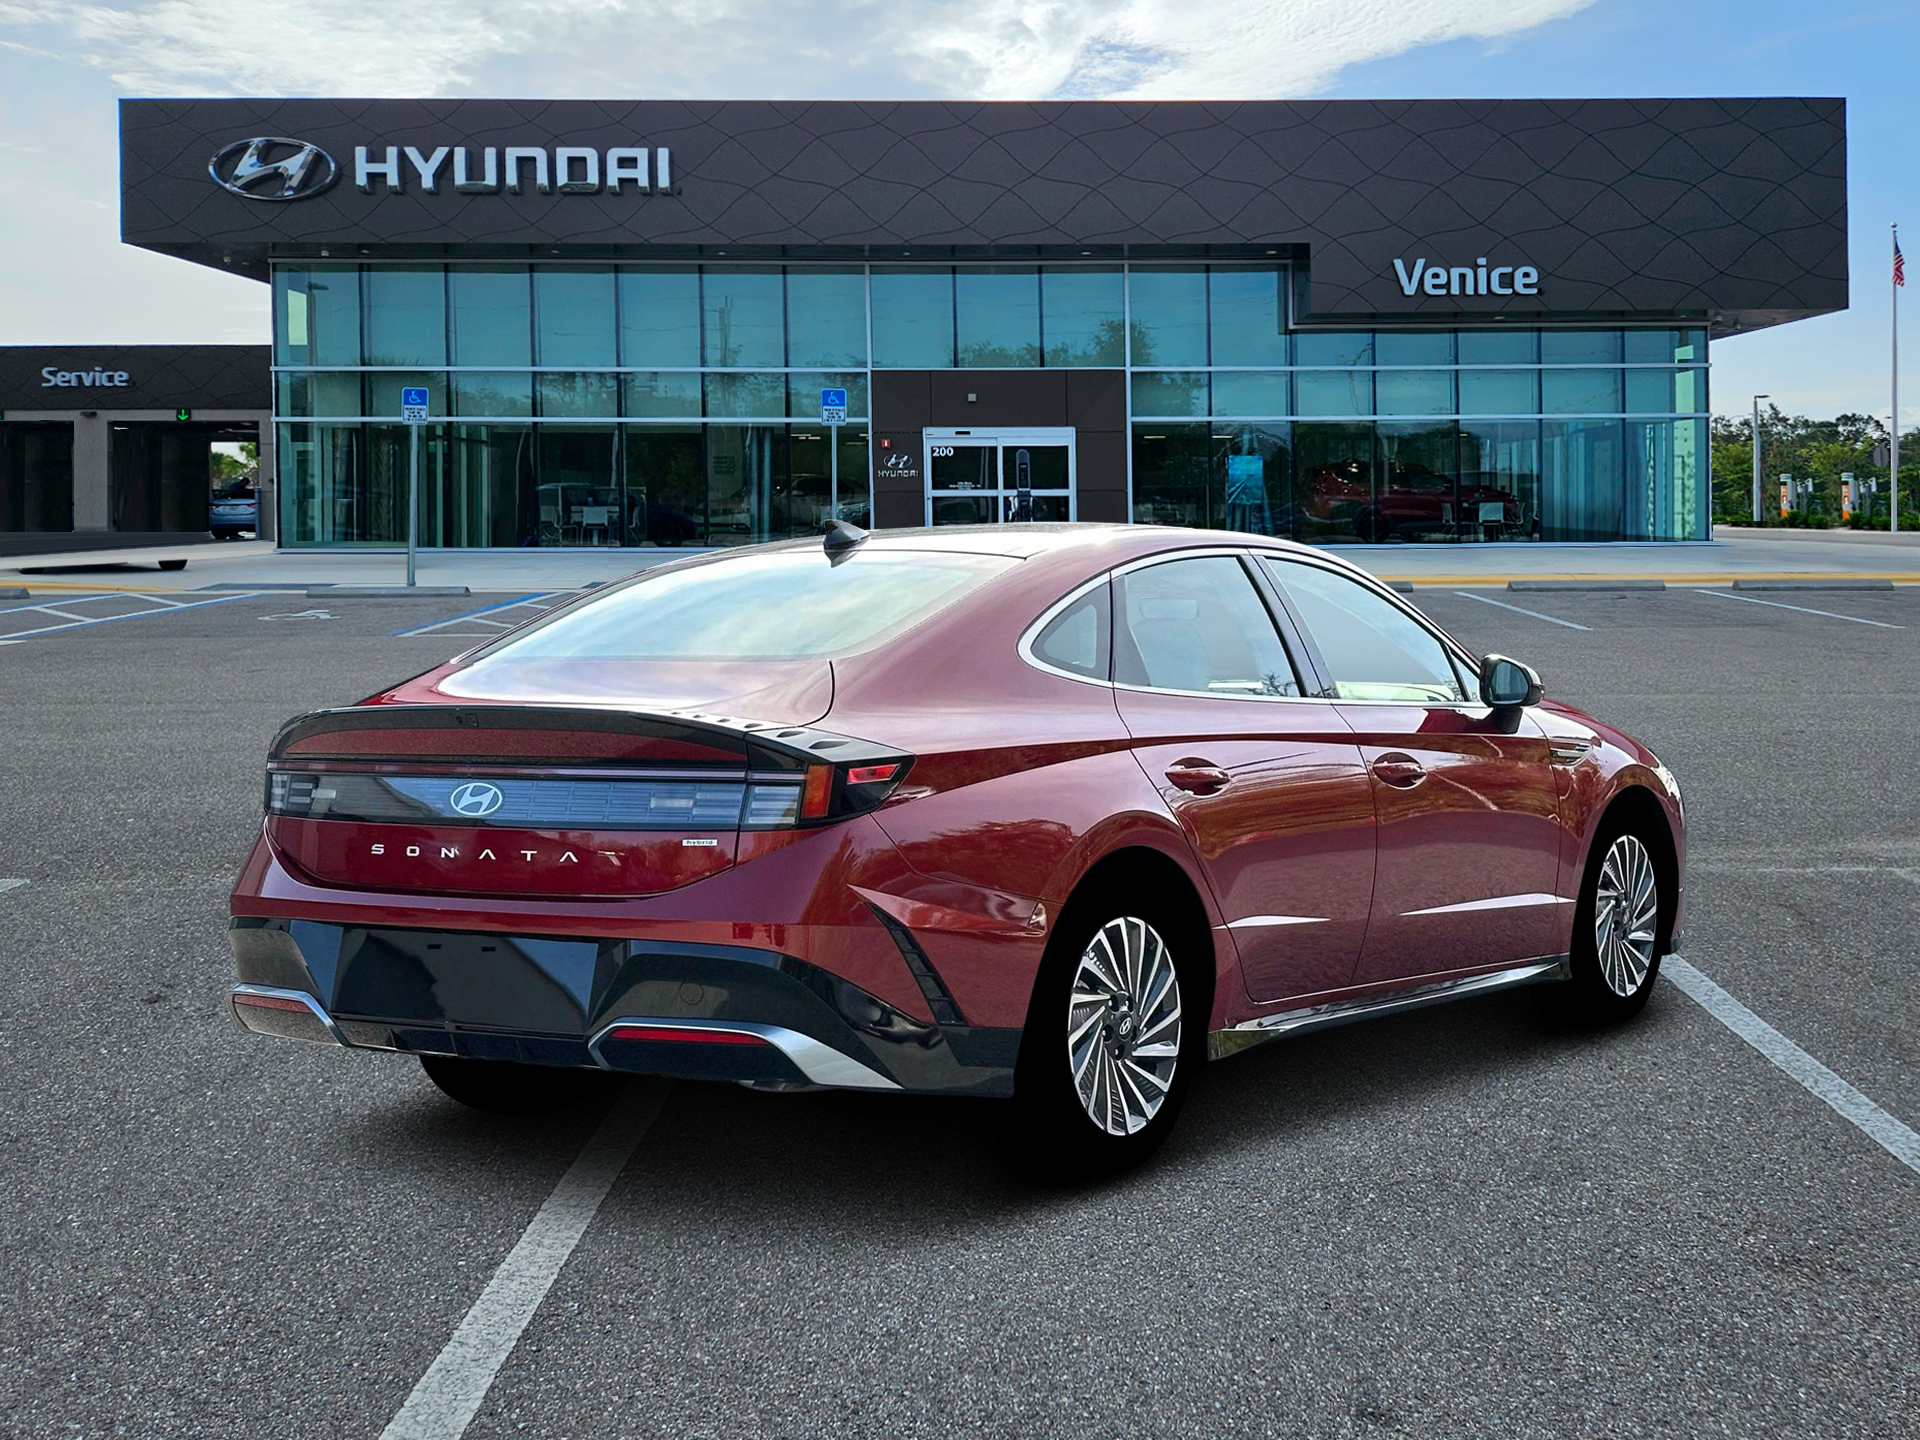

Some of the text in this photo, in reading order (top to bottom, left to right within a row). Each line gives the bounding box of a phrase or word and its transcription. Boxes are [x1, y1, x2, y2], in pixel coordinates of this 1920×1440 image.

[354, 146, 670, 194] HYUNDAI
[1392, 257, 1539, 296] Venice
[41, 366, 130, 387] Service
[932, 447, 954, 457] 200
[370, 843, 579, 863] SONATA
